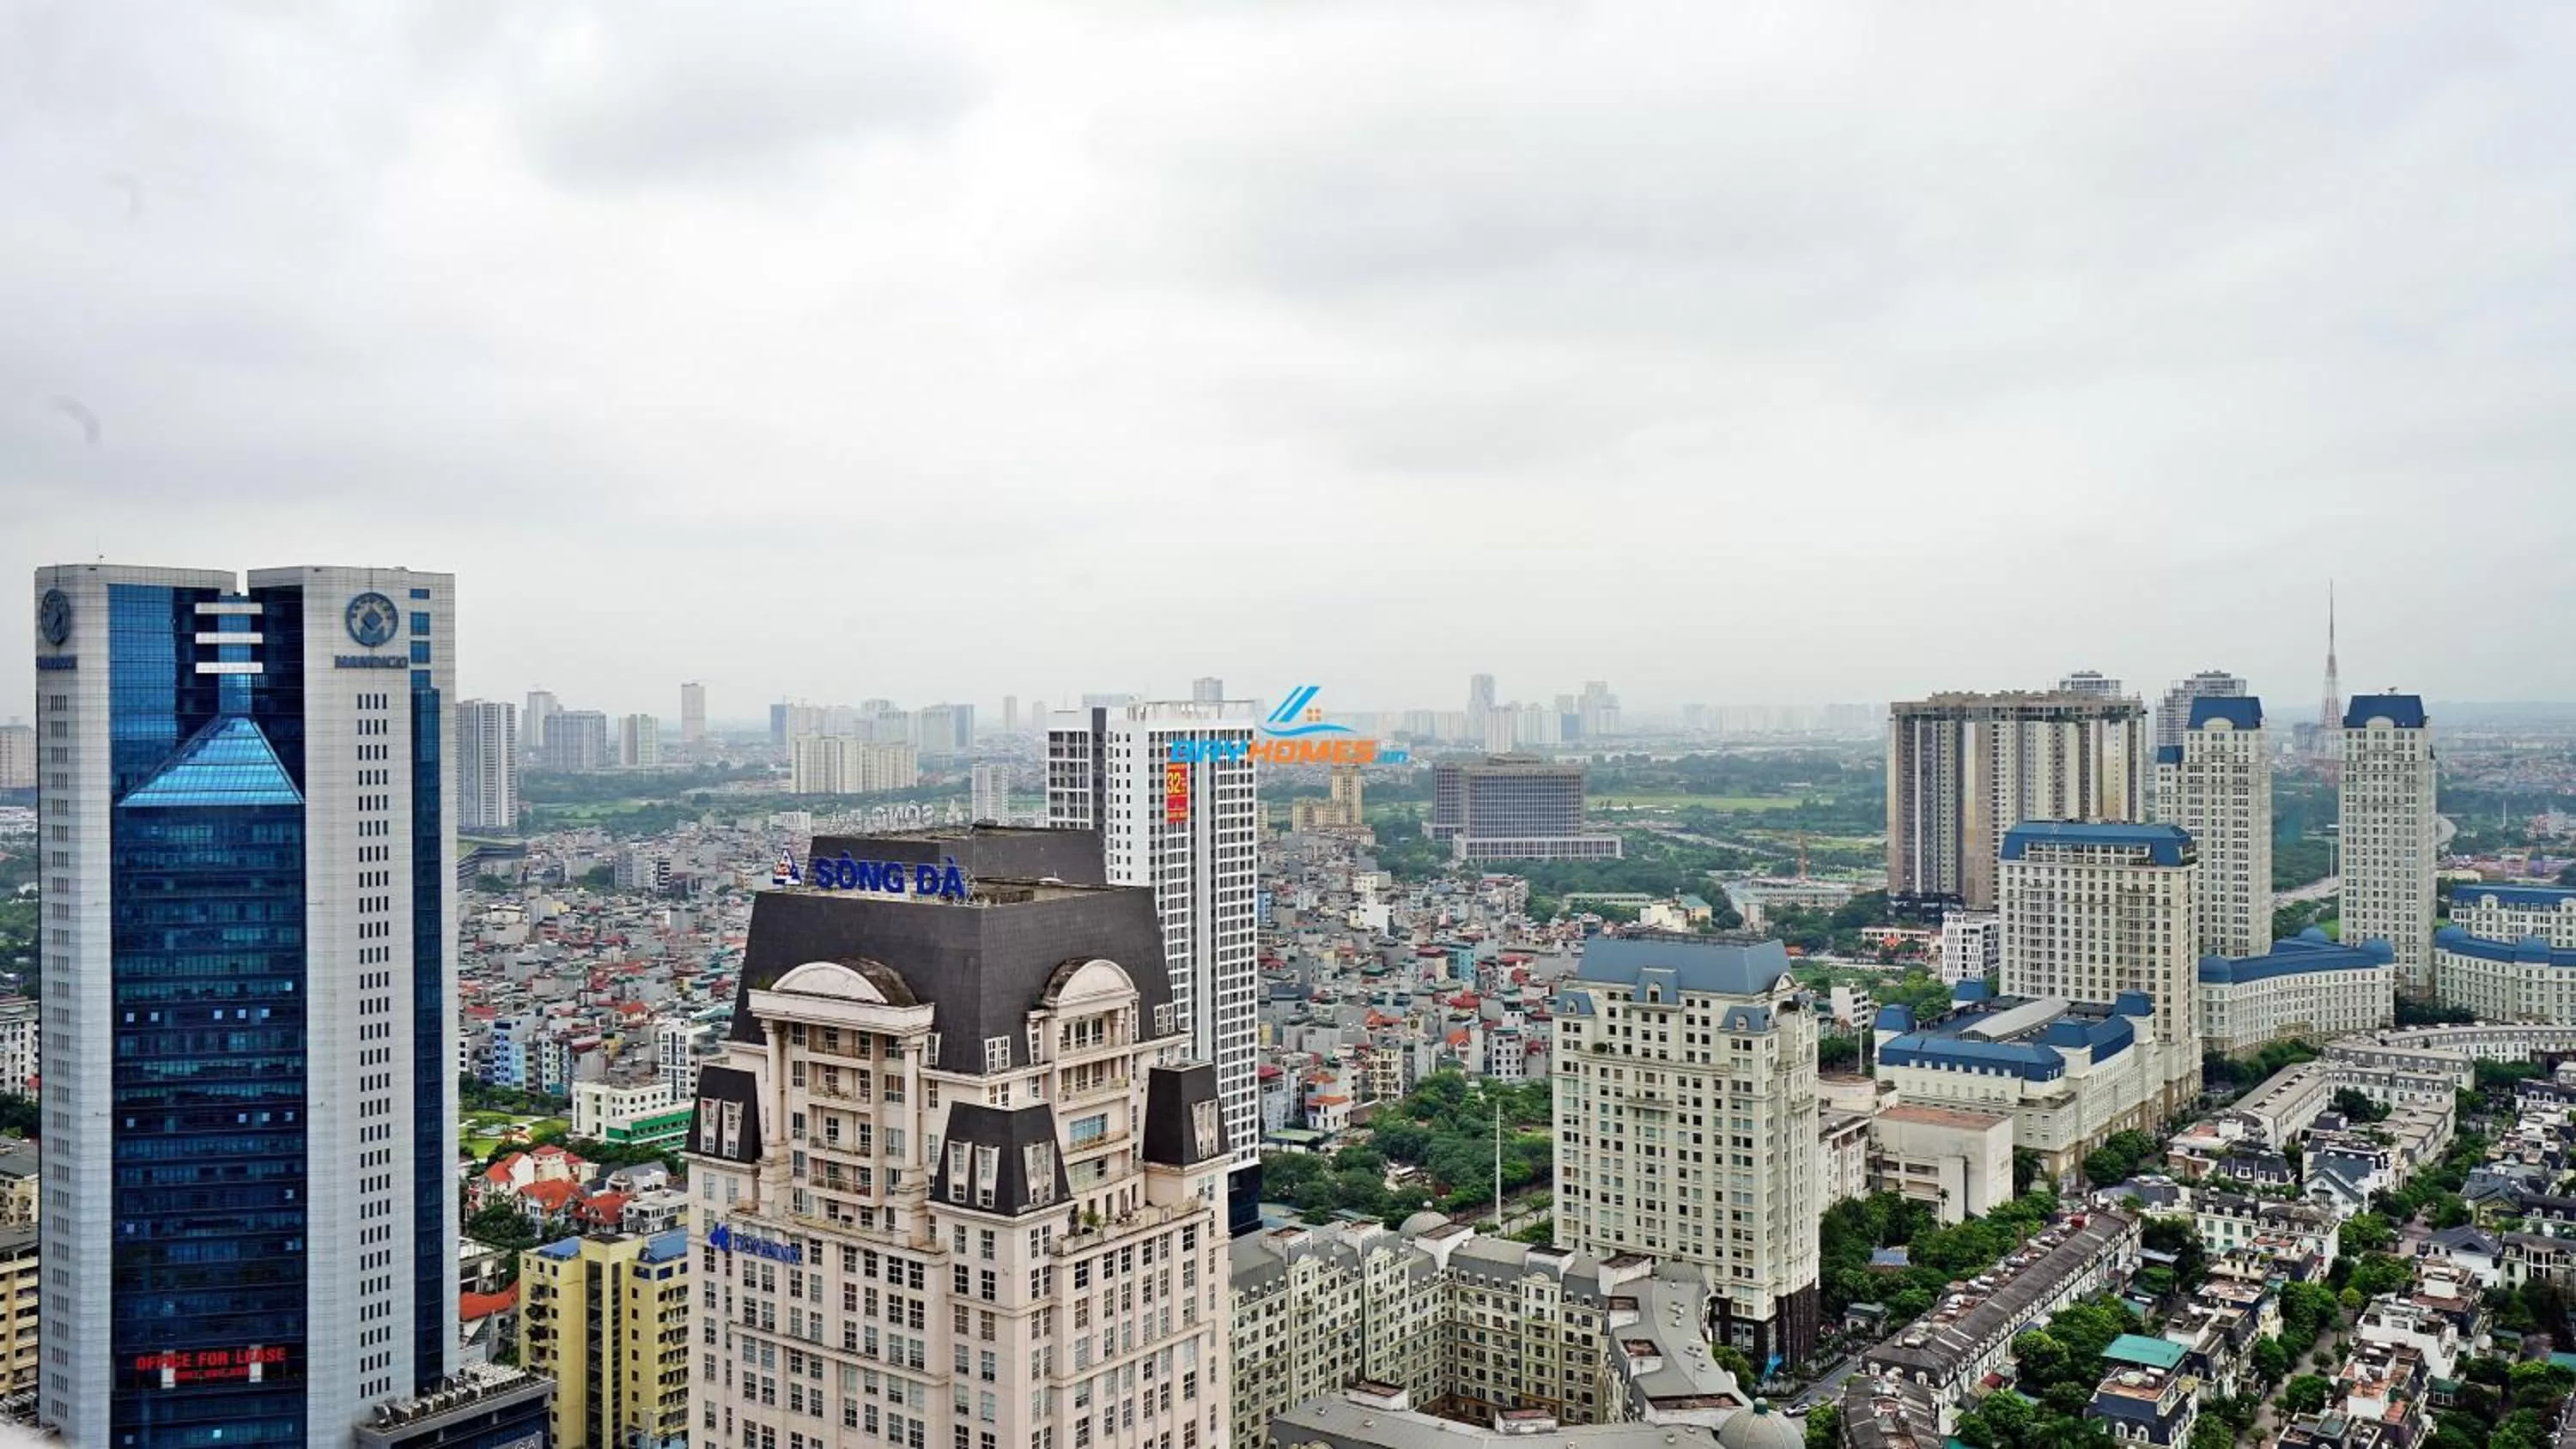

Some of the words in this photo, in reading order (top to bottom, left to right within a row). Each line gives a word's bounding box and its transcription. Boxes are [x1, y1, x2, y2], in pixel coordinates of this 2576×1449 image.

[1167, 772, 1181, 794] 32
[815, 850, 905, 894] SÔNG
[916, 857, 966, 900] ĐÀ
[197, 1350, 229, 1367] FOR
